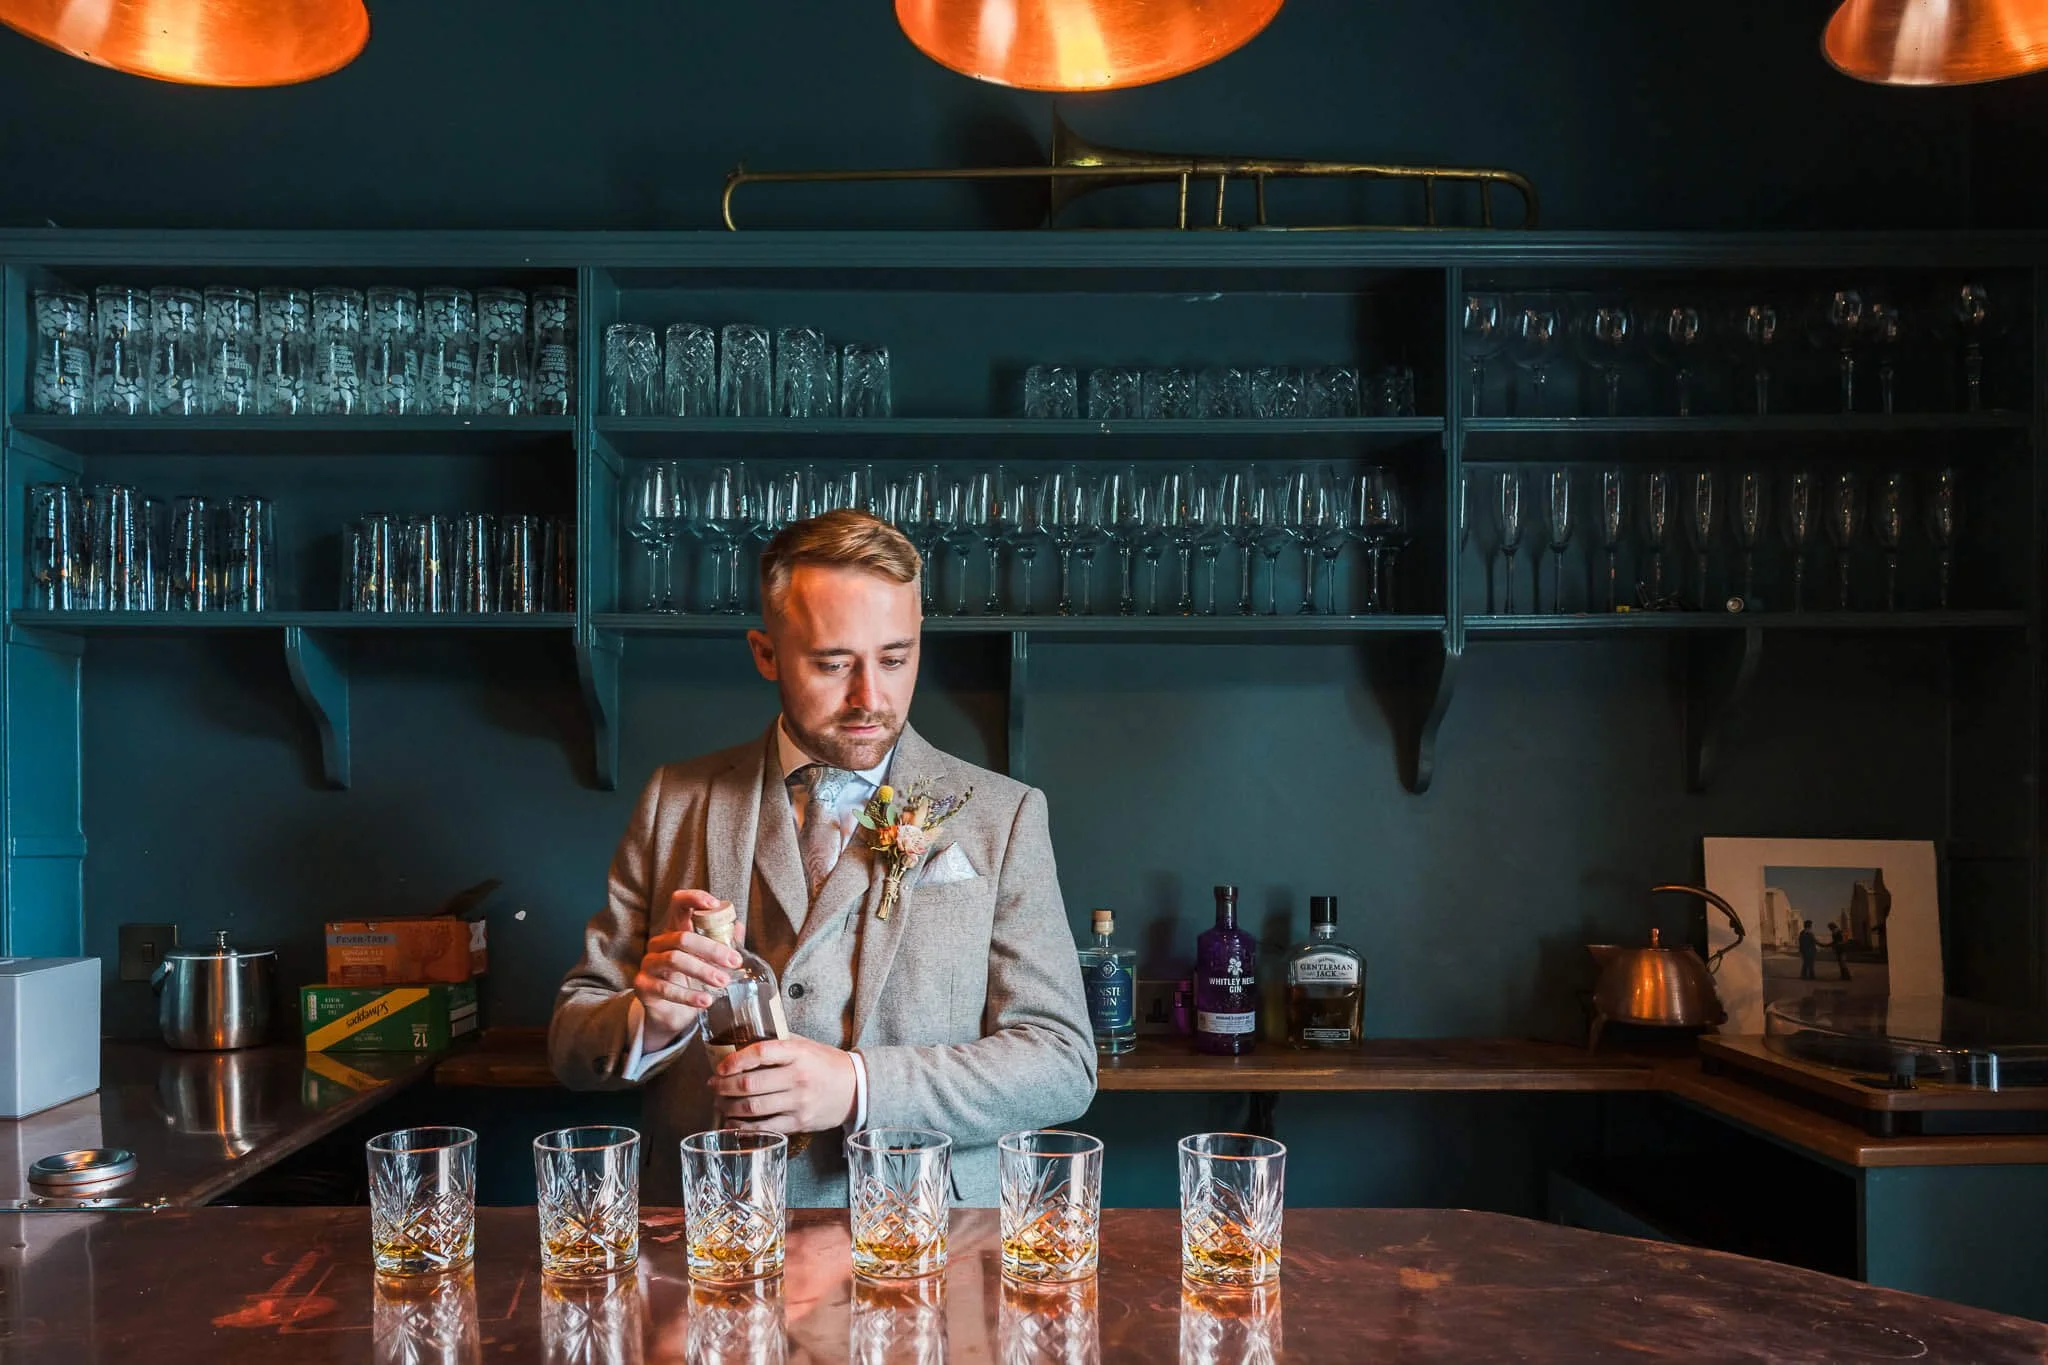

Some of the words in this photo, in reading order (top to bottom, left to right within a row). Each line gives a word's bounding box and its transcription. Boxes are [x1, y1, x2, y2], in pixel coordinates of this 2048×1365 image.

[1209, 977, 1240, 985] WHITLEY
[346, 1001, 390, 1028] Schweppes
[413, 1033, 428, 1048] 12
